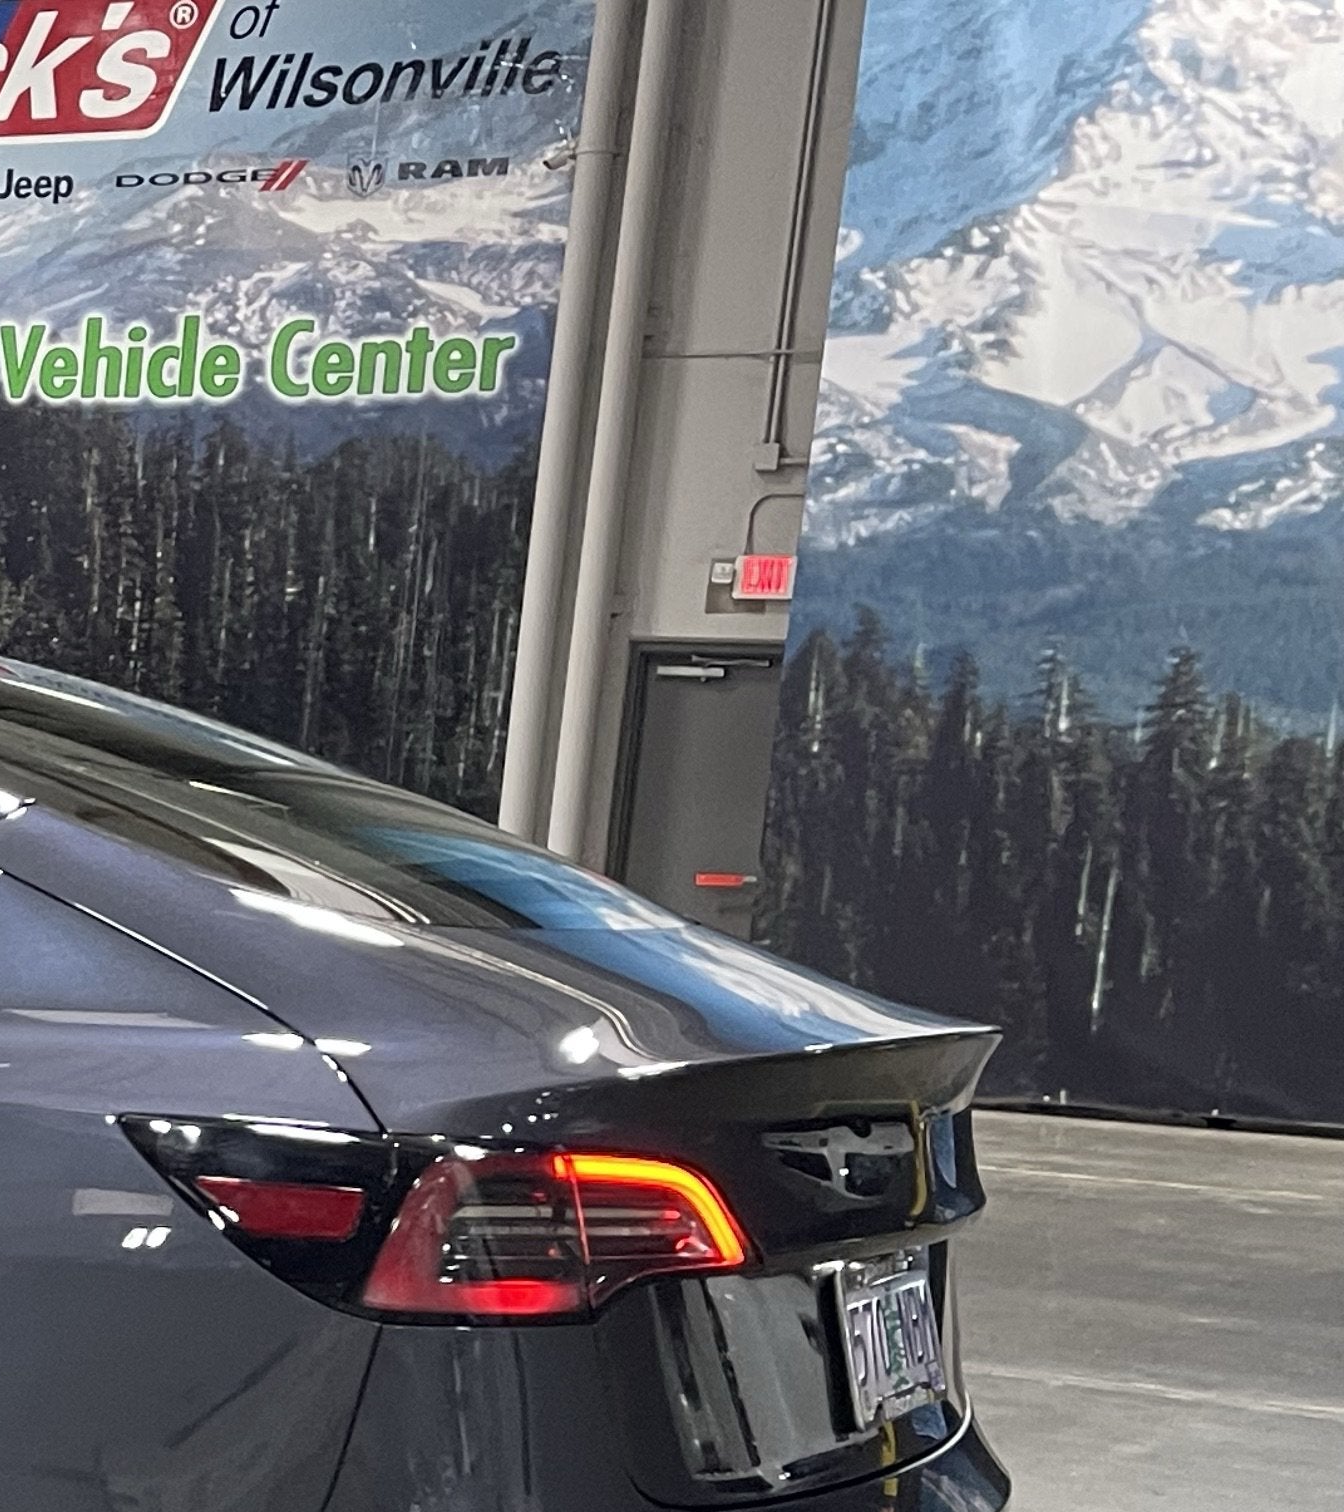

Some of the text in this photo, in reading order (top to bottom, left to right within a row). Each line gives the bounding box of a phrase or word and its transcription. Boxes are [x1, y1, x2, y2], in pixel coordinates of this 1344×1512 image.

[229, 0, 280, 40] of
[209, 37, 562, 113] Wilsonville
[115, 166, 280, 189] DODGE
[397, 157, 510, 181] RAM
[0, 314, 242, 400] Vehicle
[267, 319, 515, 397] Center
